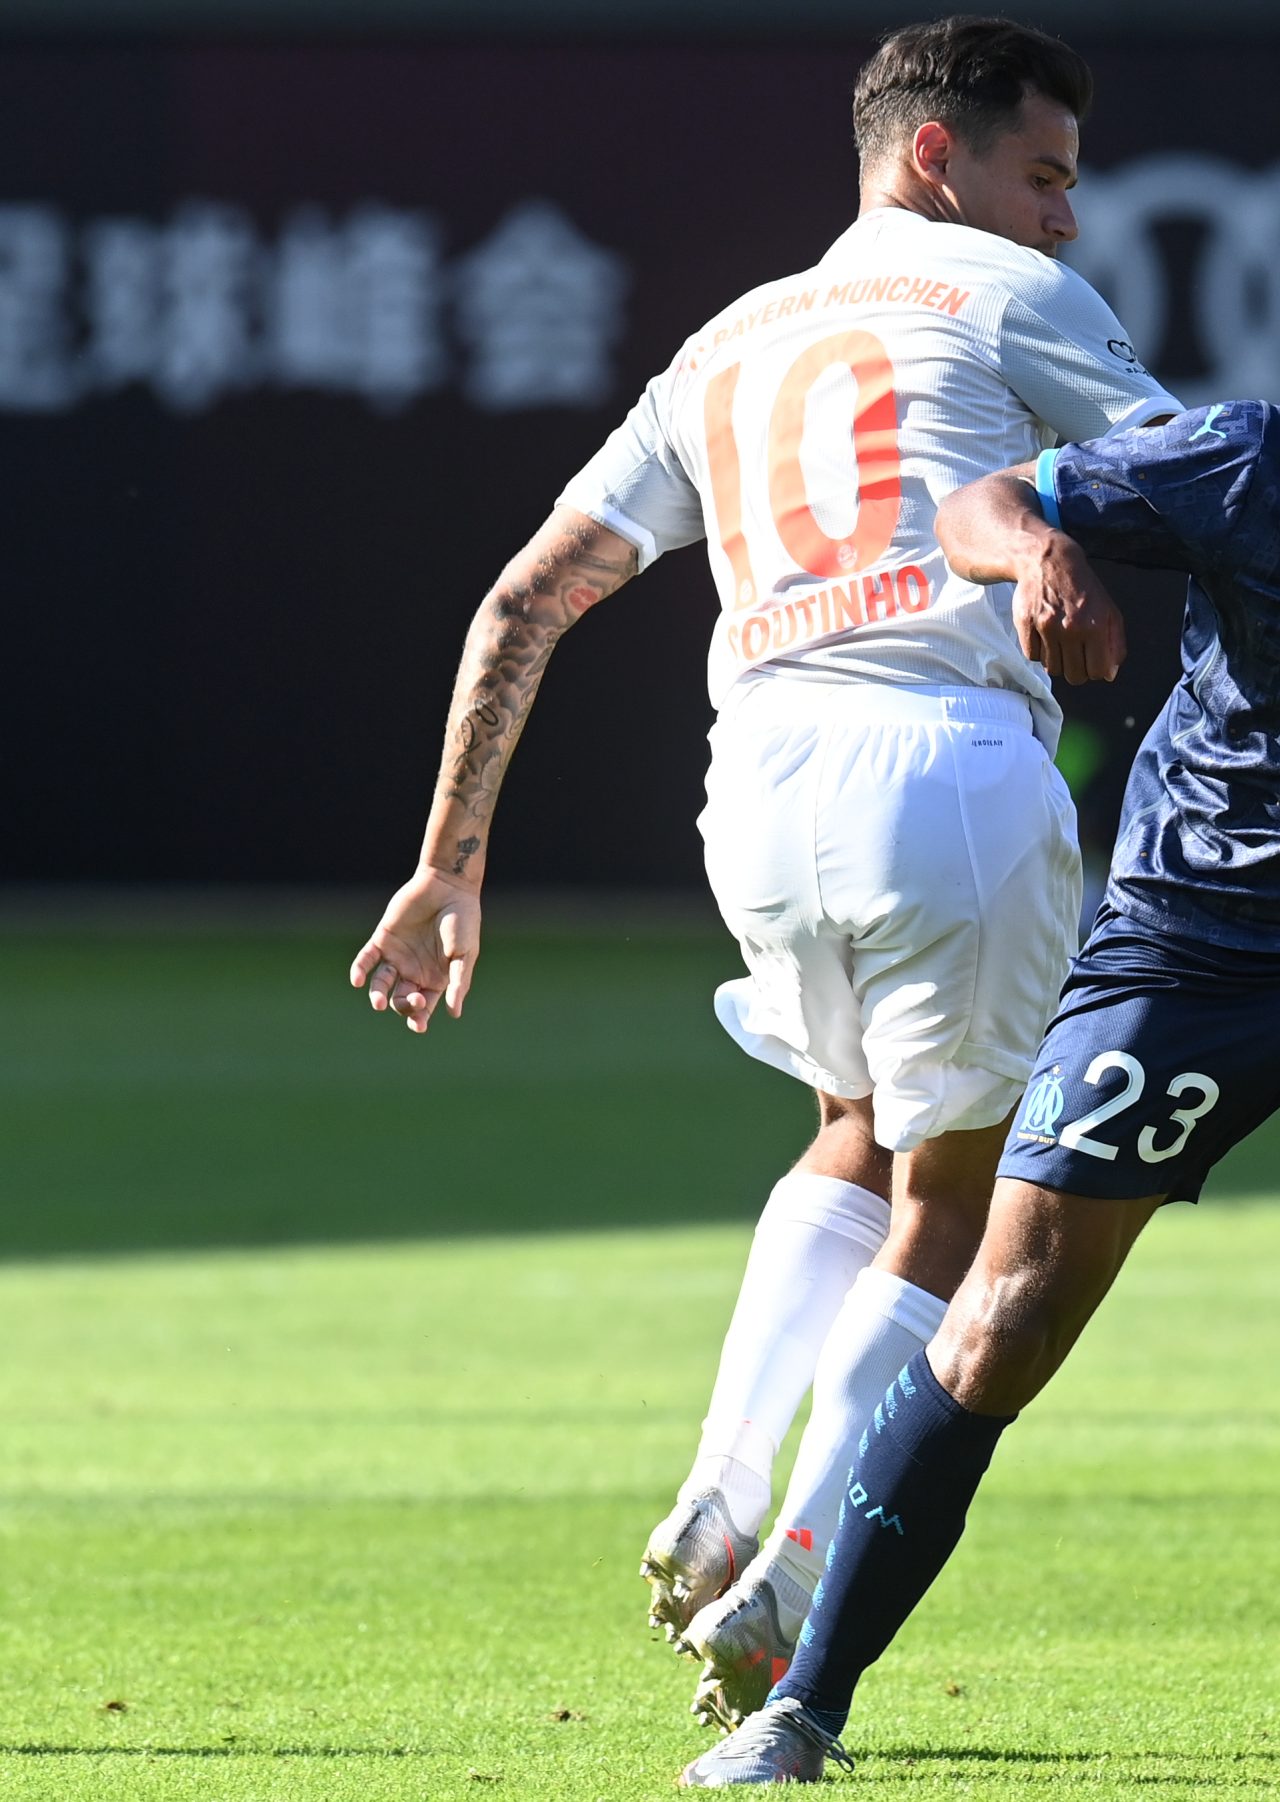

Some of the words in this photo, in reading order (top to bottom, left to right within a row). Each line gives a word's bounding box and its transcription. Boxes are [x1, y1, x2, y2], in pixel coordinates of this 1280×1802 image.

[713, 289, 819, 347] BAYERN
[702, 329, 901, 613] 10
[1058, 1050, 1220, 1164] 23
